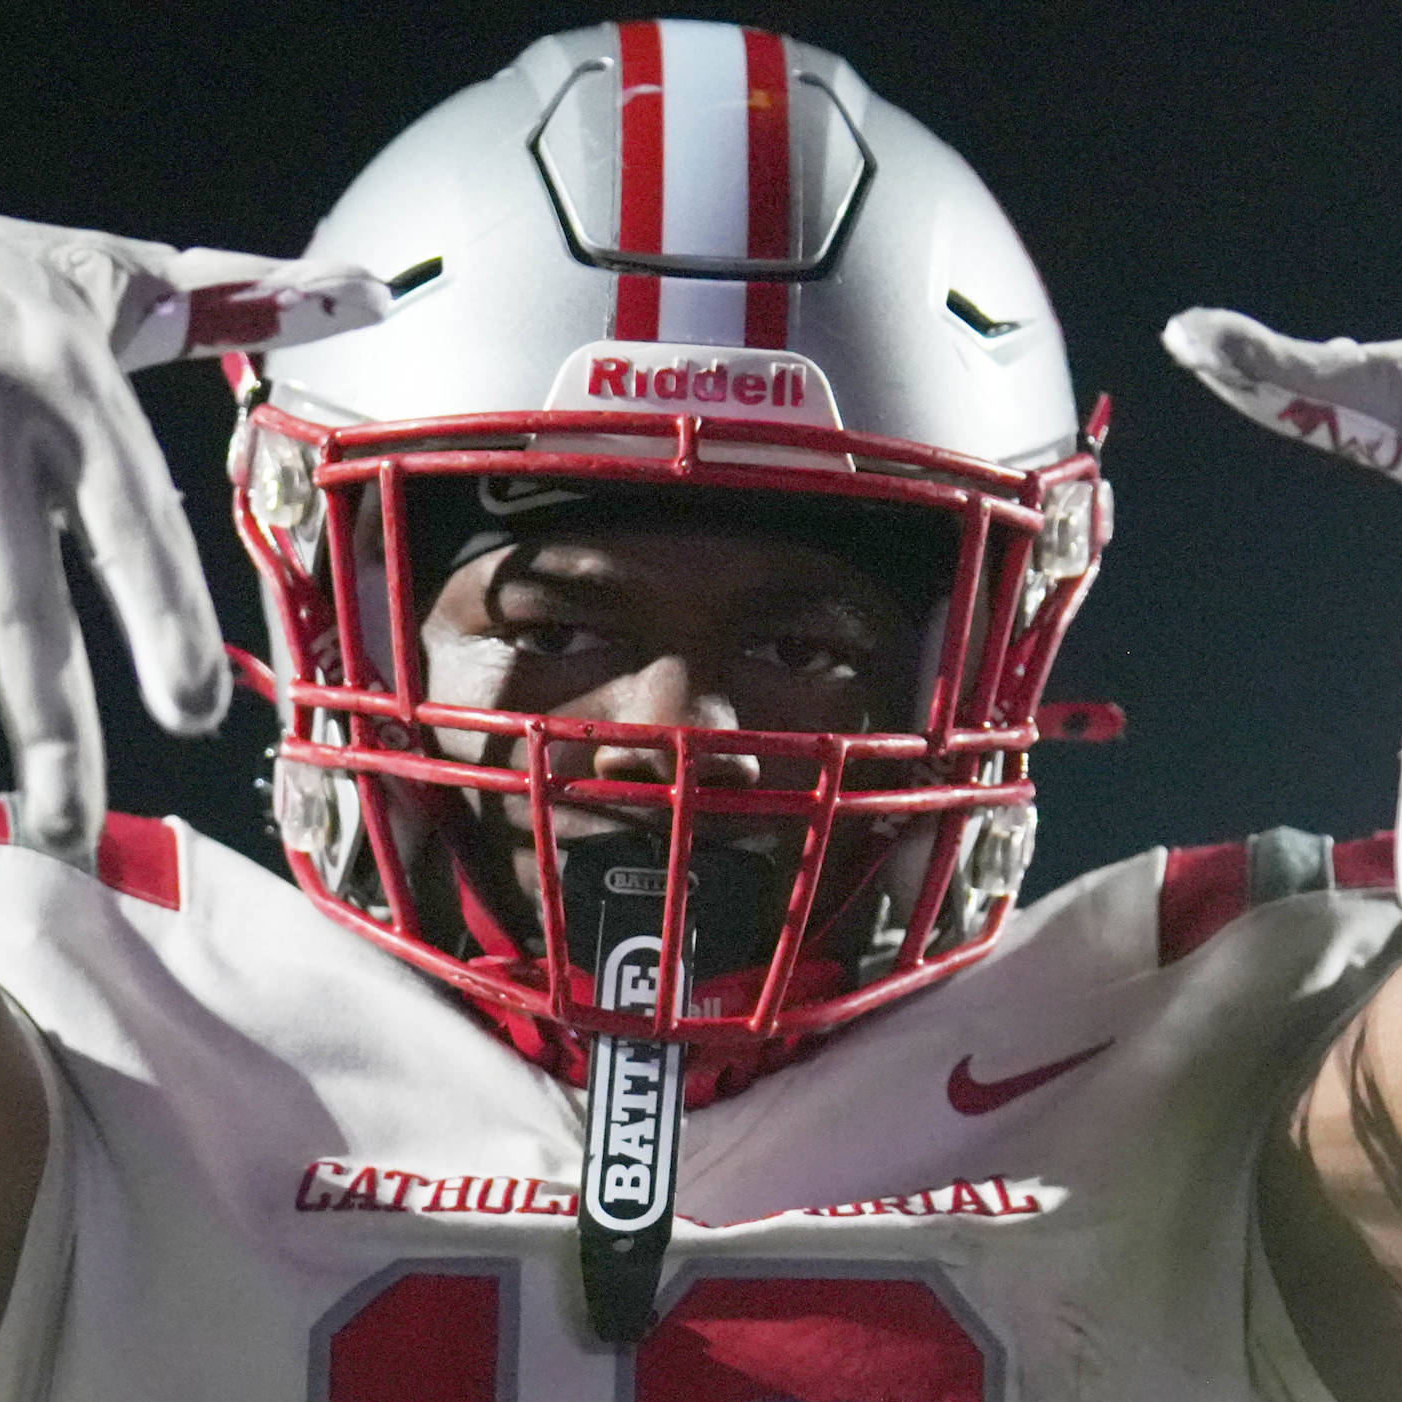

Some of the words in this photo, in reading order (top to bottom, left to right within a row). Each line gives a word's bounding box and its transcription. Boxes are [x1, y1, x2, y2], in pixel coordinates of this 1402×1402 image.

[588, 356, 807, 407] Riddell
[613, 872, 667, 890] BATT
[604, 964, 663, 1205] BATTE
[295, 1161, 579, 1216] CATHOL
